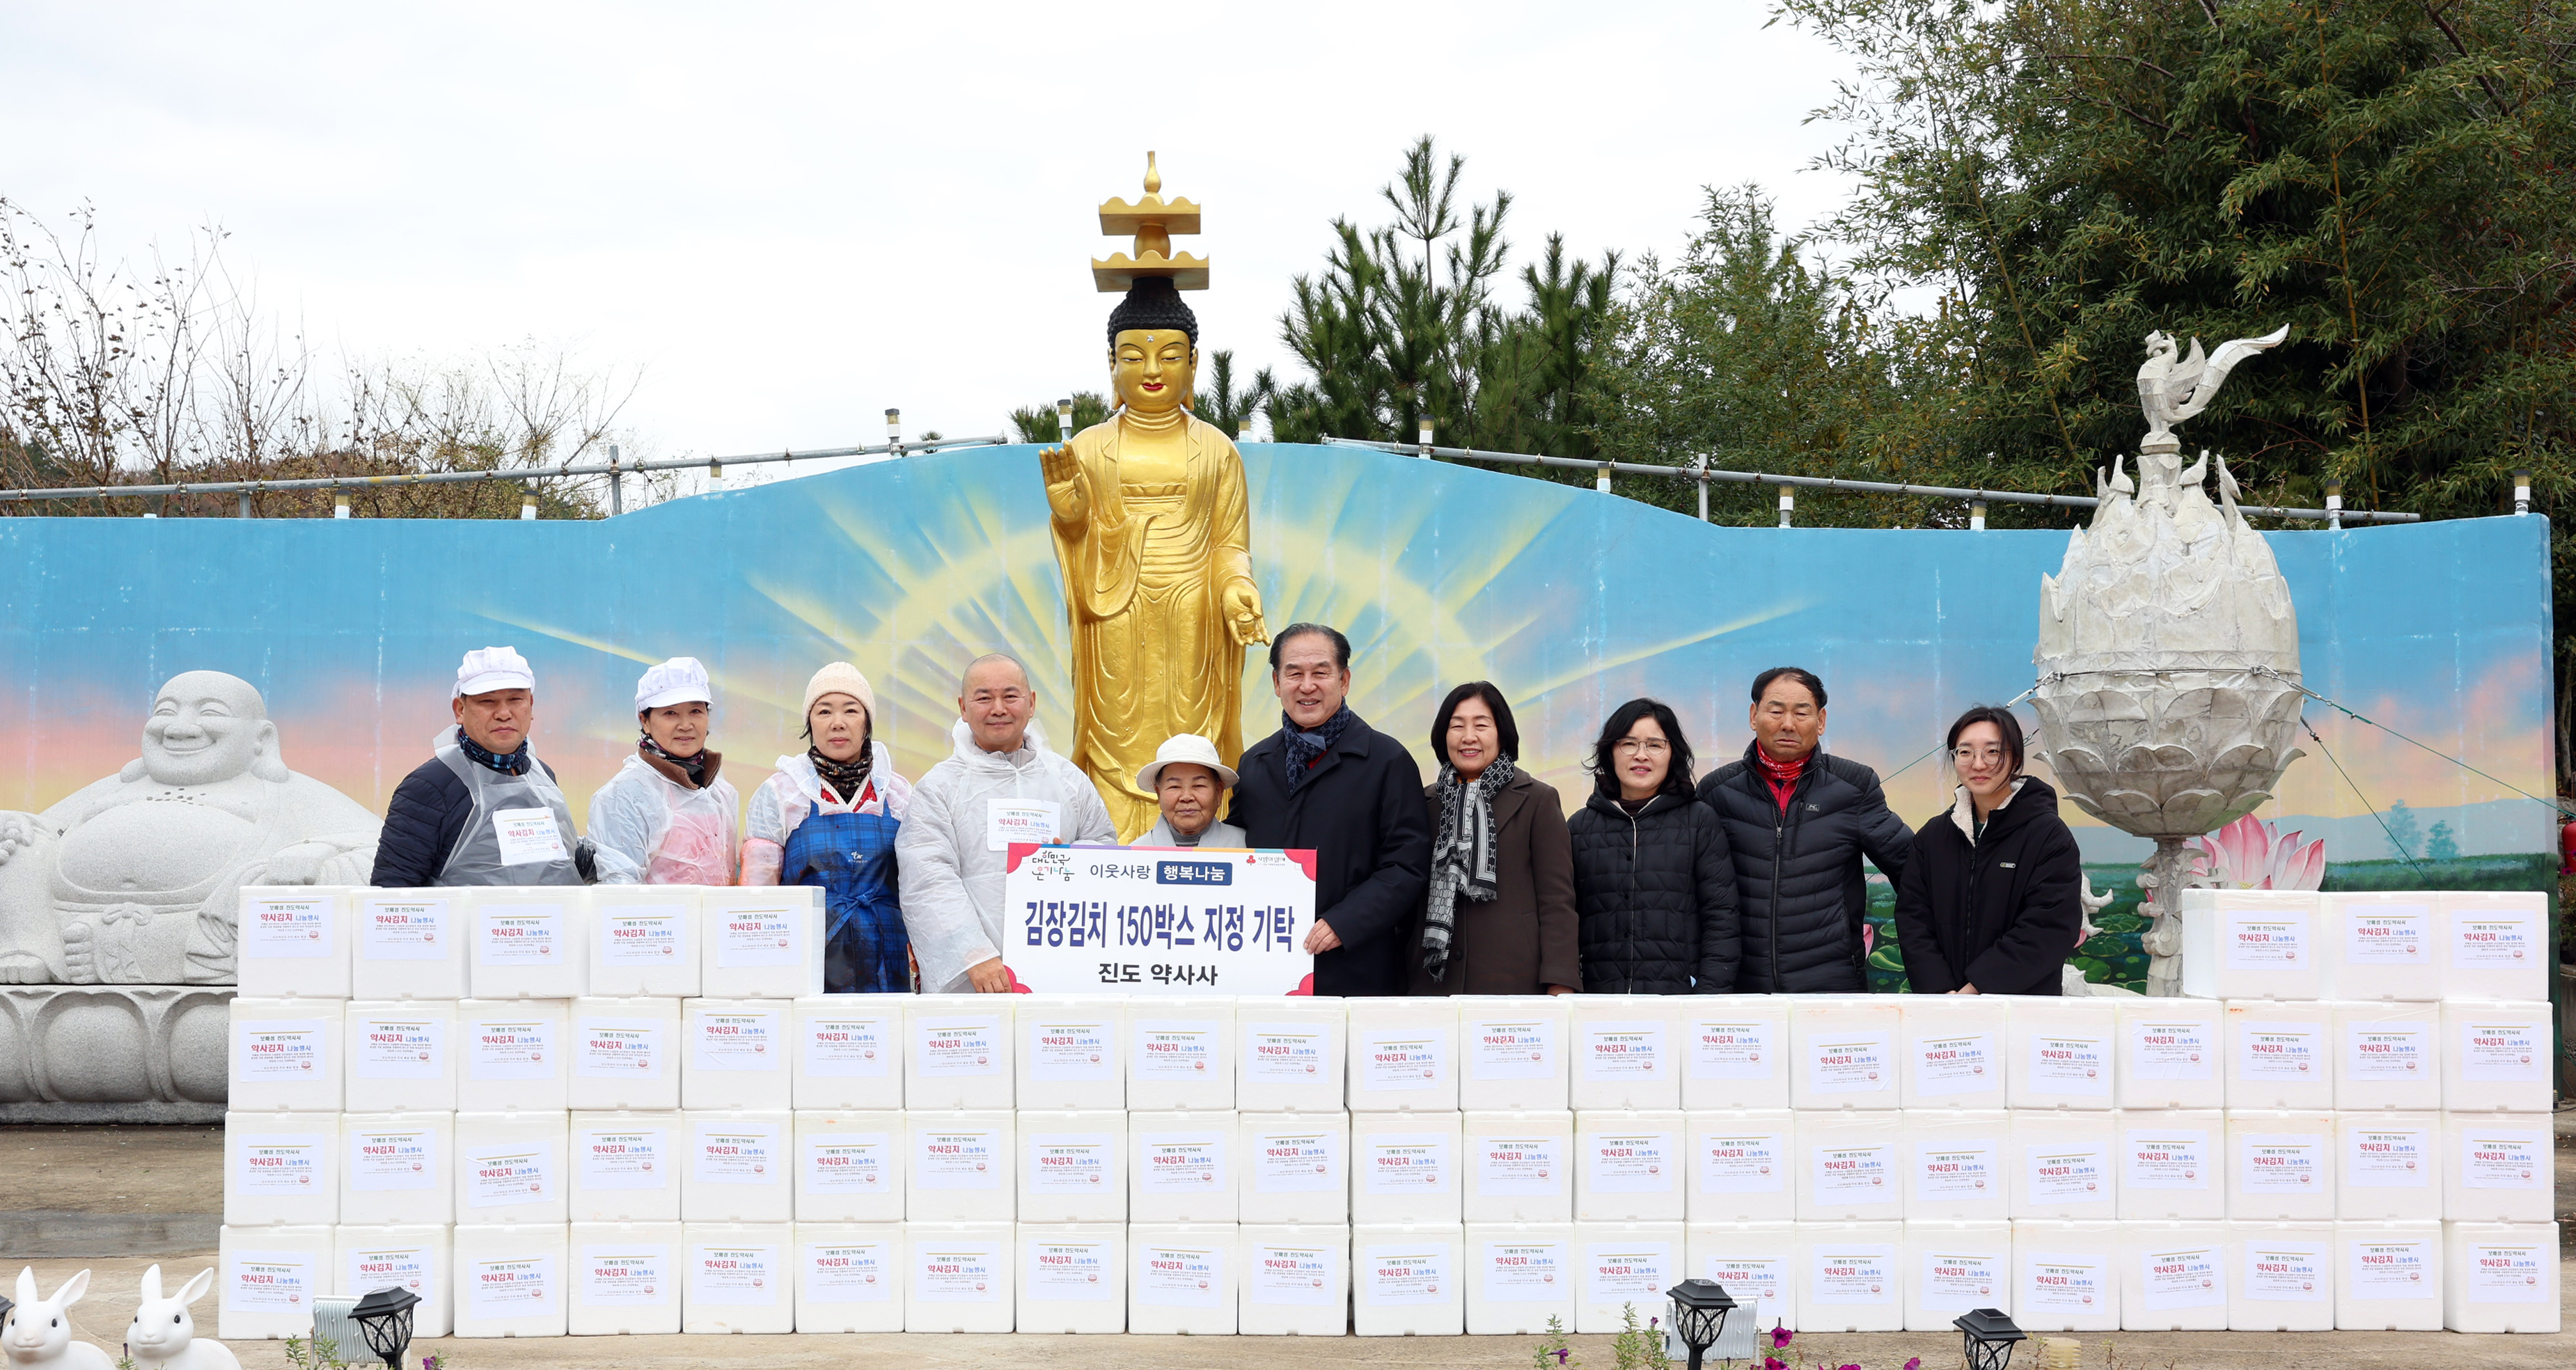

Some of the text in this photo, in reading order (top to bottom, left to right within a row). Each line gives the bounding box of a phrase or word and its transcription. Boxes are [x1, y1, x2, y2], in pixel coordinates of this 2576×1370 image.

[998, 818, 1028, 826] 약사김치
[508, 829, 535, 837] 약사김치
[1032, 850, 1071, 866] 대한민국
[1032, 866, 1075, 881] 온기나눔
[1090, 864, 1225, 882] 이웃사랑 행복나눔
[260, 913, 292, 922] 약사김치
[1026, 900, 1295, 952] 김장김치 150박스 지정 기탁
[492, 928, 523, 936] 약사김치
[613, 929, 645, 938] 약사김치
[2358, 927, 2389, 936] 약사김치
[2238, 934, 2269, 942] 약사김치
[1098, 963, 1218, 986] 진도 약사사
[707, 1026, 738, 1034] 약사김치
[370, 1033, 402, 1042] 약사김치
[1042, 1037, 1073, 1045] 약사김치
[1703, 1035, 1733, 1044] 약사김치
[251, 1044, 284, 1053] 약사김치
[590, 1040, 622, 1049] 약사김치
[929, 1039, 960, 1049] 약사김치
[1595, 1044, 1626, 1053] 약사김치
[2252, 1044, 2282, 1053] 약사김치
[1258, 1046, 1289, 1055] 약사김치
[2041, 1050, 2071, 1059] 약사김치
[1375, 1053, 1406, 1062] 약사김치
[1926, 1050, 1956, 1061] 약사김치
[363, 1145, 395, 1154] 약사김치
[592, 1144, 625, 1154] 약사김치
[707, 1145, 738, 1155] 약사김치
[929, 1144, 959, 1154] 약사김치
[1267, 1147, 1298, 1157] 약사김치
[1601, 1148, 1633, 1157] 약사김치
[1490, 1151, 1521, 1160] 약사김치
[2137, 1152, 2169, 1160] 약사김치
[2474, 1151, 2505, 1160] 약사김치
[250, 1157, 283, 1166] 약사김치
[1153, 1156, 1185, 1165] 약사김치
[1825, 1160, 1855, 1170] 약사김치
[2254, 1157, 2284, 1165] 약사김치
[1928, 1163, 1958, 1172] 약사김치
[817, 1257, 849, 1267] 약사김치
[1151, 1260, 1182, 1270] 약사김치
[1265, 1259, 1296, 1268] 약사김치
[1495, 1257, 1527, 1265] 약사김치
[2480, 1259, 2510, 1267] 약사김치
[927, 1264, 959, 1273] 약사김치
[1599, 1266, 1631, 1275] 약사김치
[1825, 1268, 1855, 1276] 약사김치
[1935, 1266, 1965, 1276] 약사김치
[2154, 1263, 2210, 1275] 약사김치 나눔행사
[2256, 1263, 2287, 1272] 약사김치
[595, 1268, 627, 1277] 약사김치
[242, 1274, 274, 1284] 약사김치
[481, 1273, 514, 1283] 약사김치
